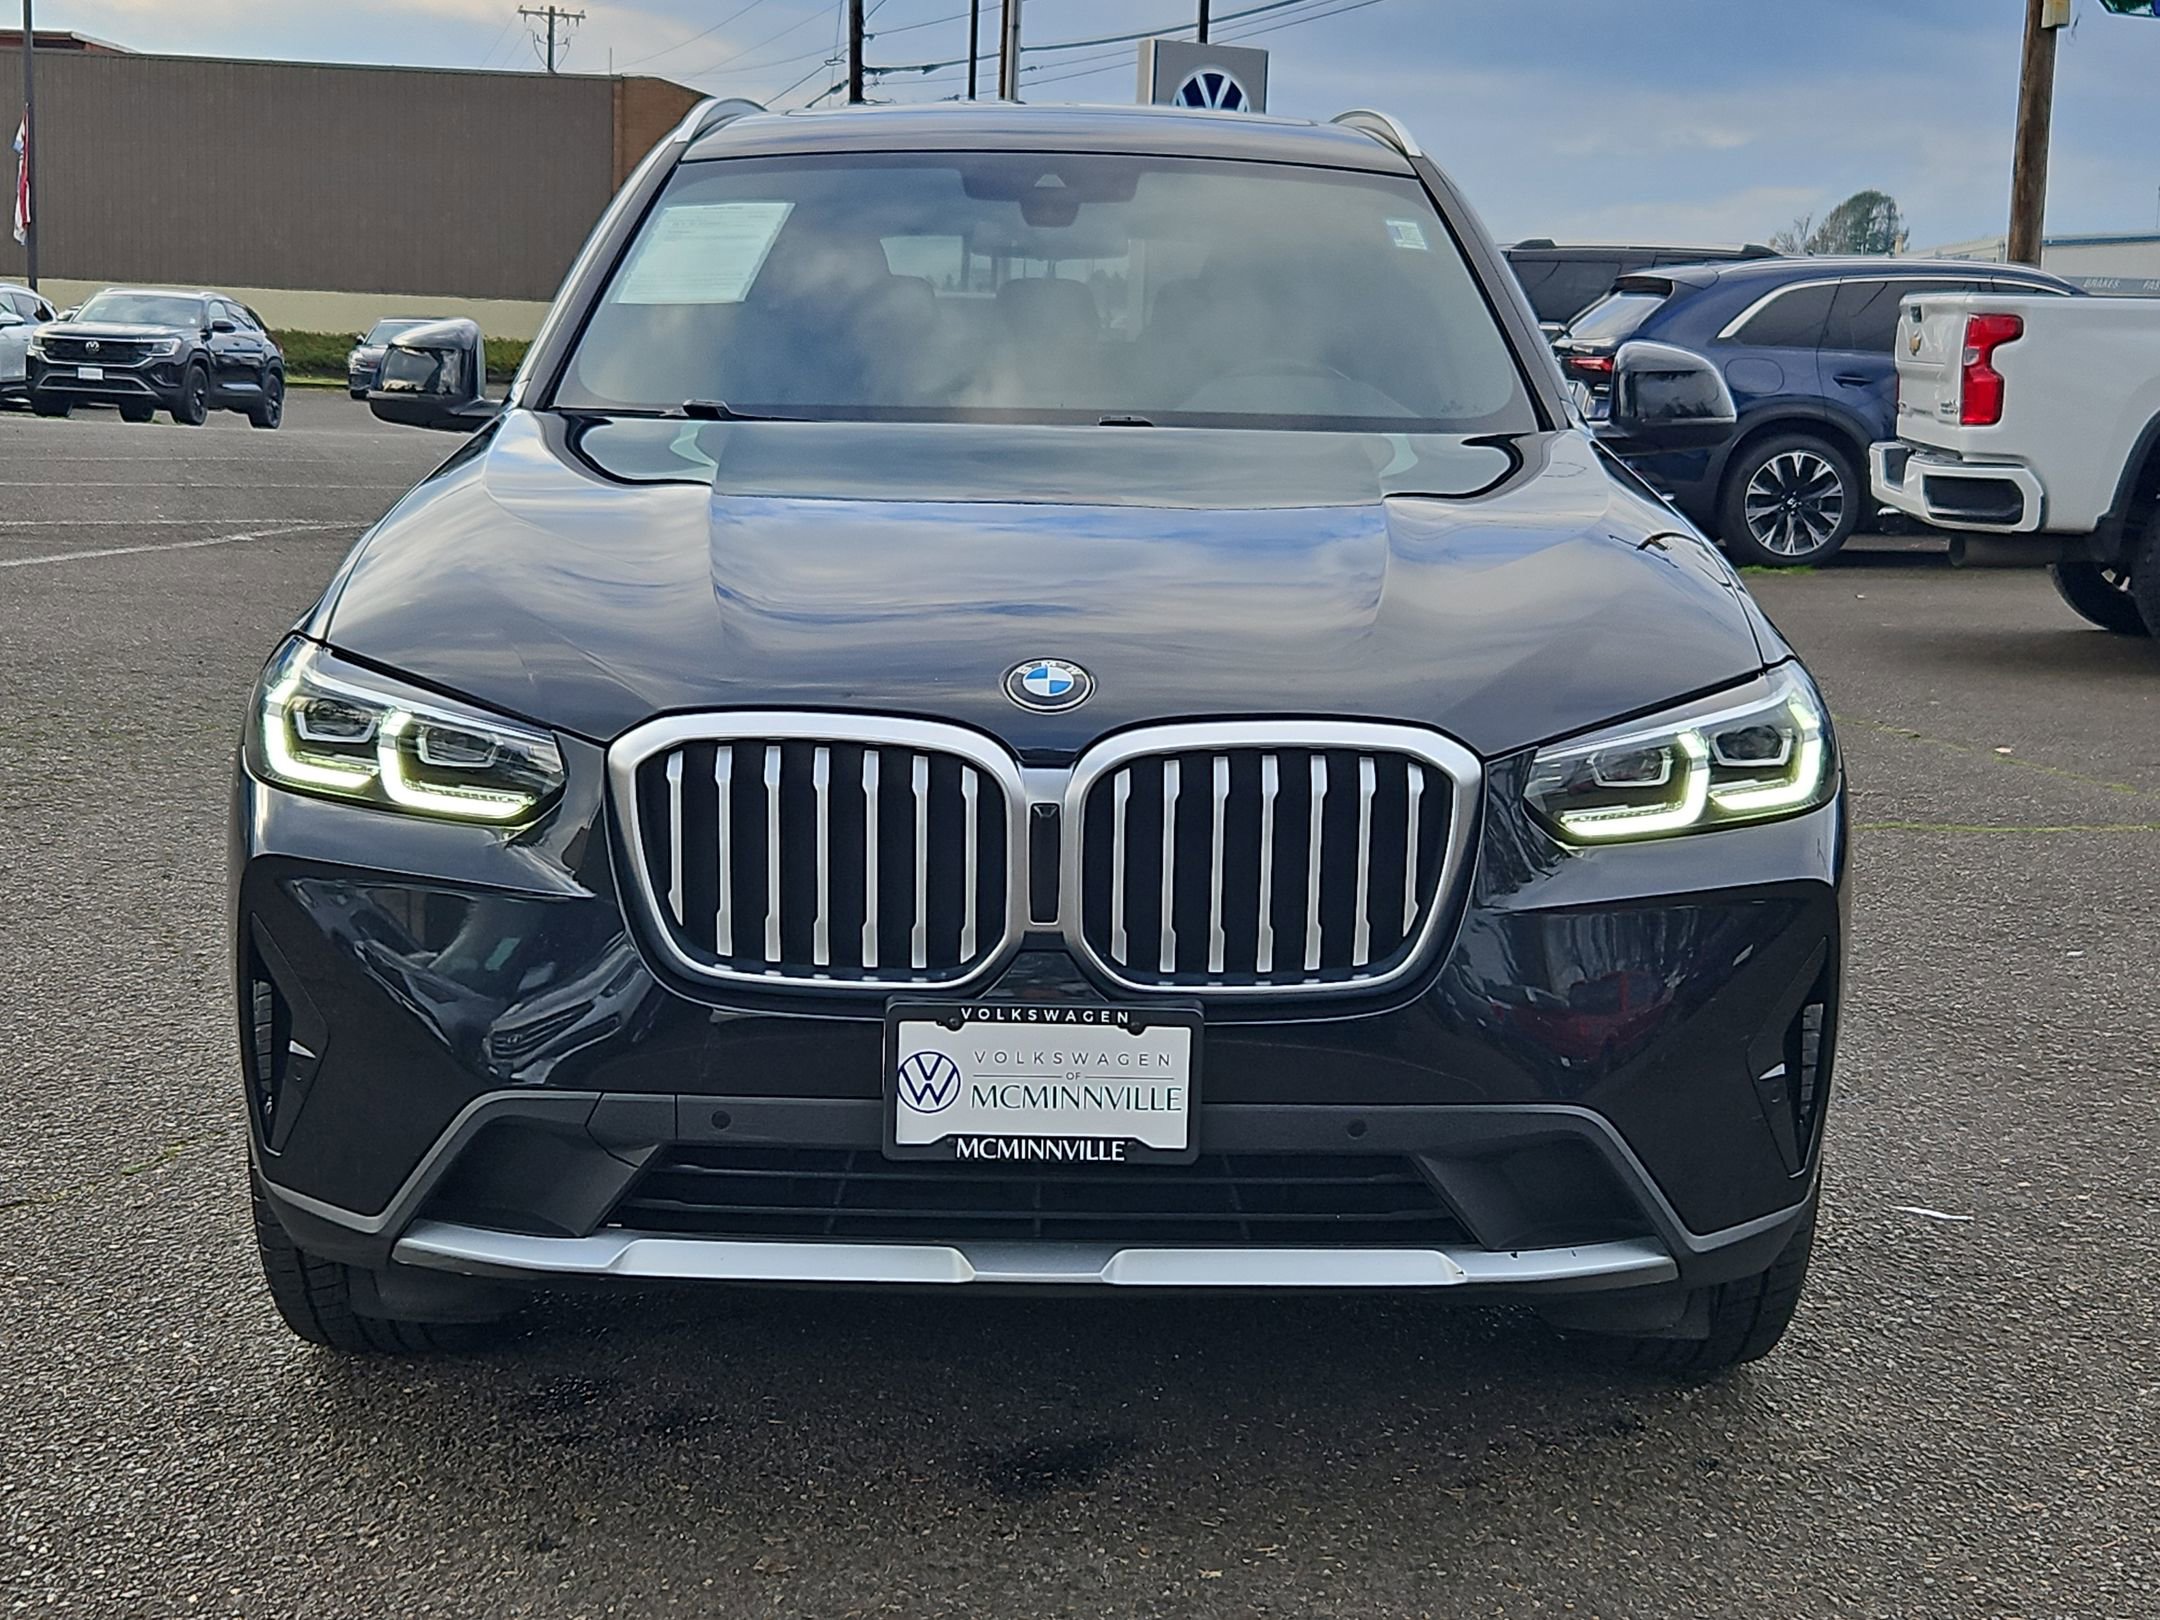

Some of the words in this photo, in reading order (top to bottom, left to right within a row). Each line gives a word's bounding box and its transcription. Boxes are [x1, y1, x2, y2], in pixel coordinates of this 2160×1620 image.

[2083, 278, 2120, 289] BRAKES
[961, 1007, 1129, 1024] VOLKSWAGEN
[974, 1051, 1170, 1066] VOLKSWAGEN
[1066, 1071, 1081, 1081] OF
[971, 1085, 1182, 1111] MCMINNVILLE
[956, 1138, 1125, 1161] MCMINNVILLE
